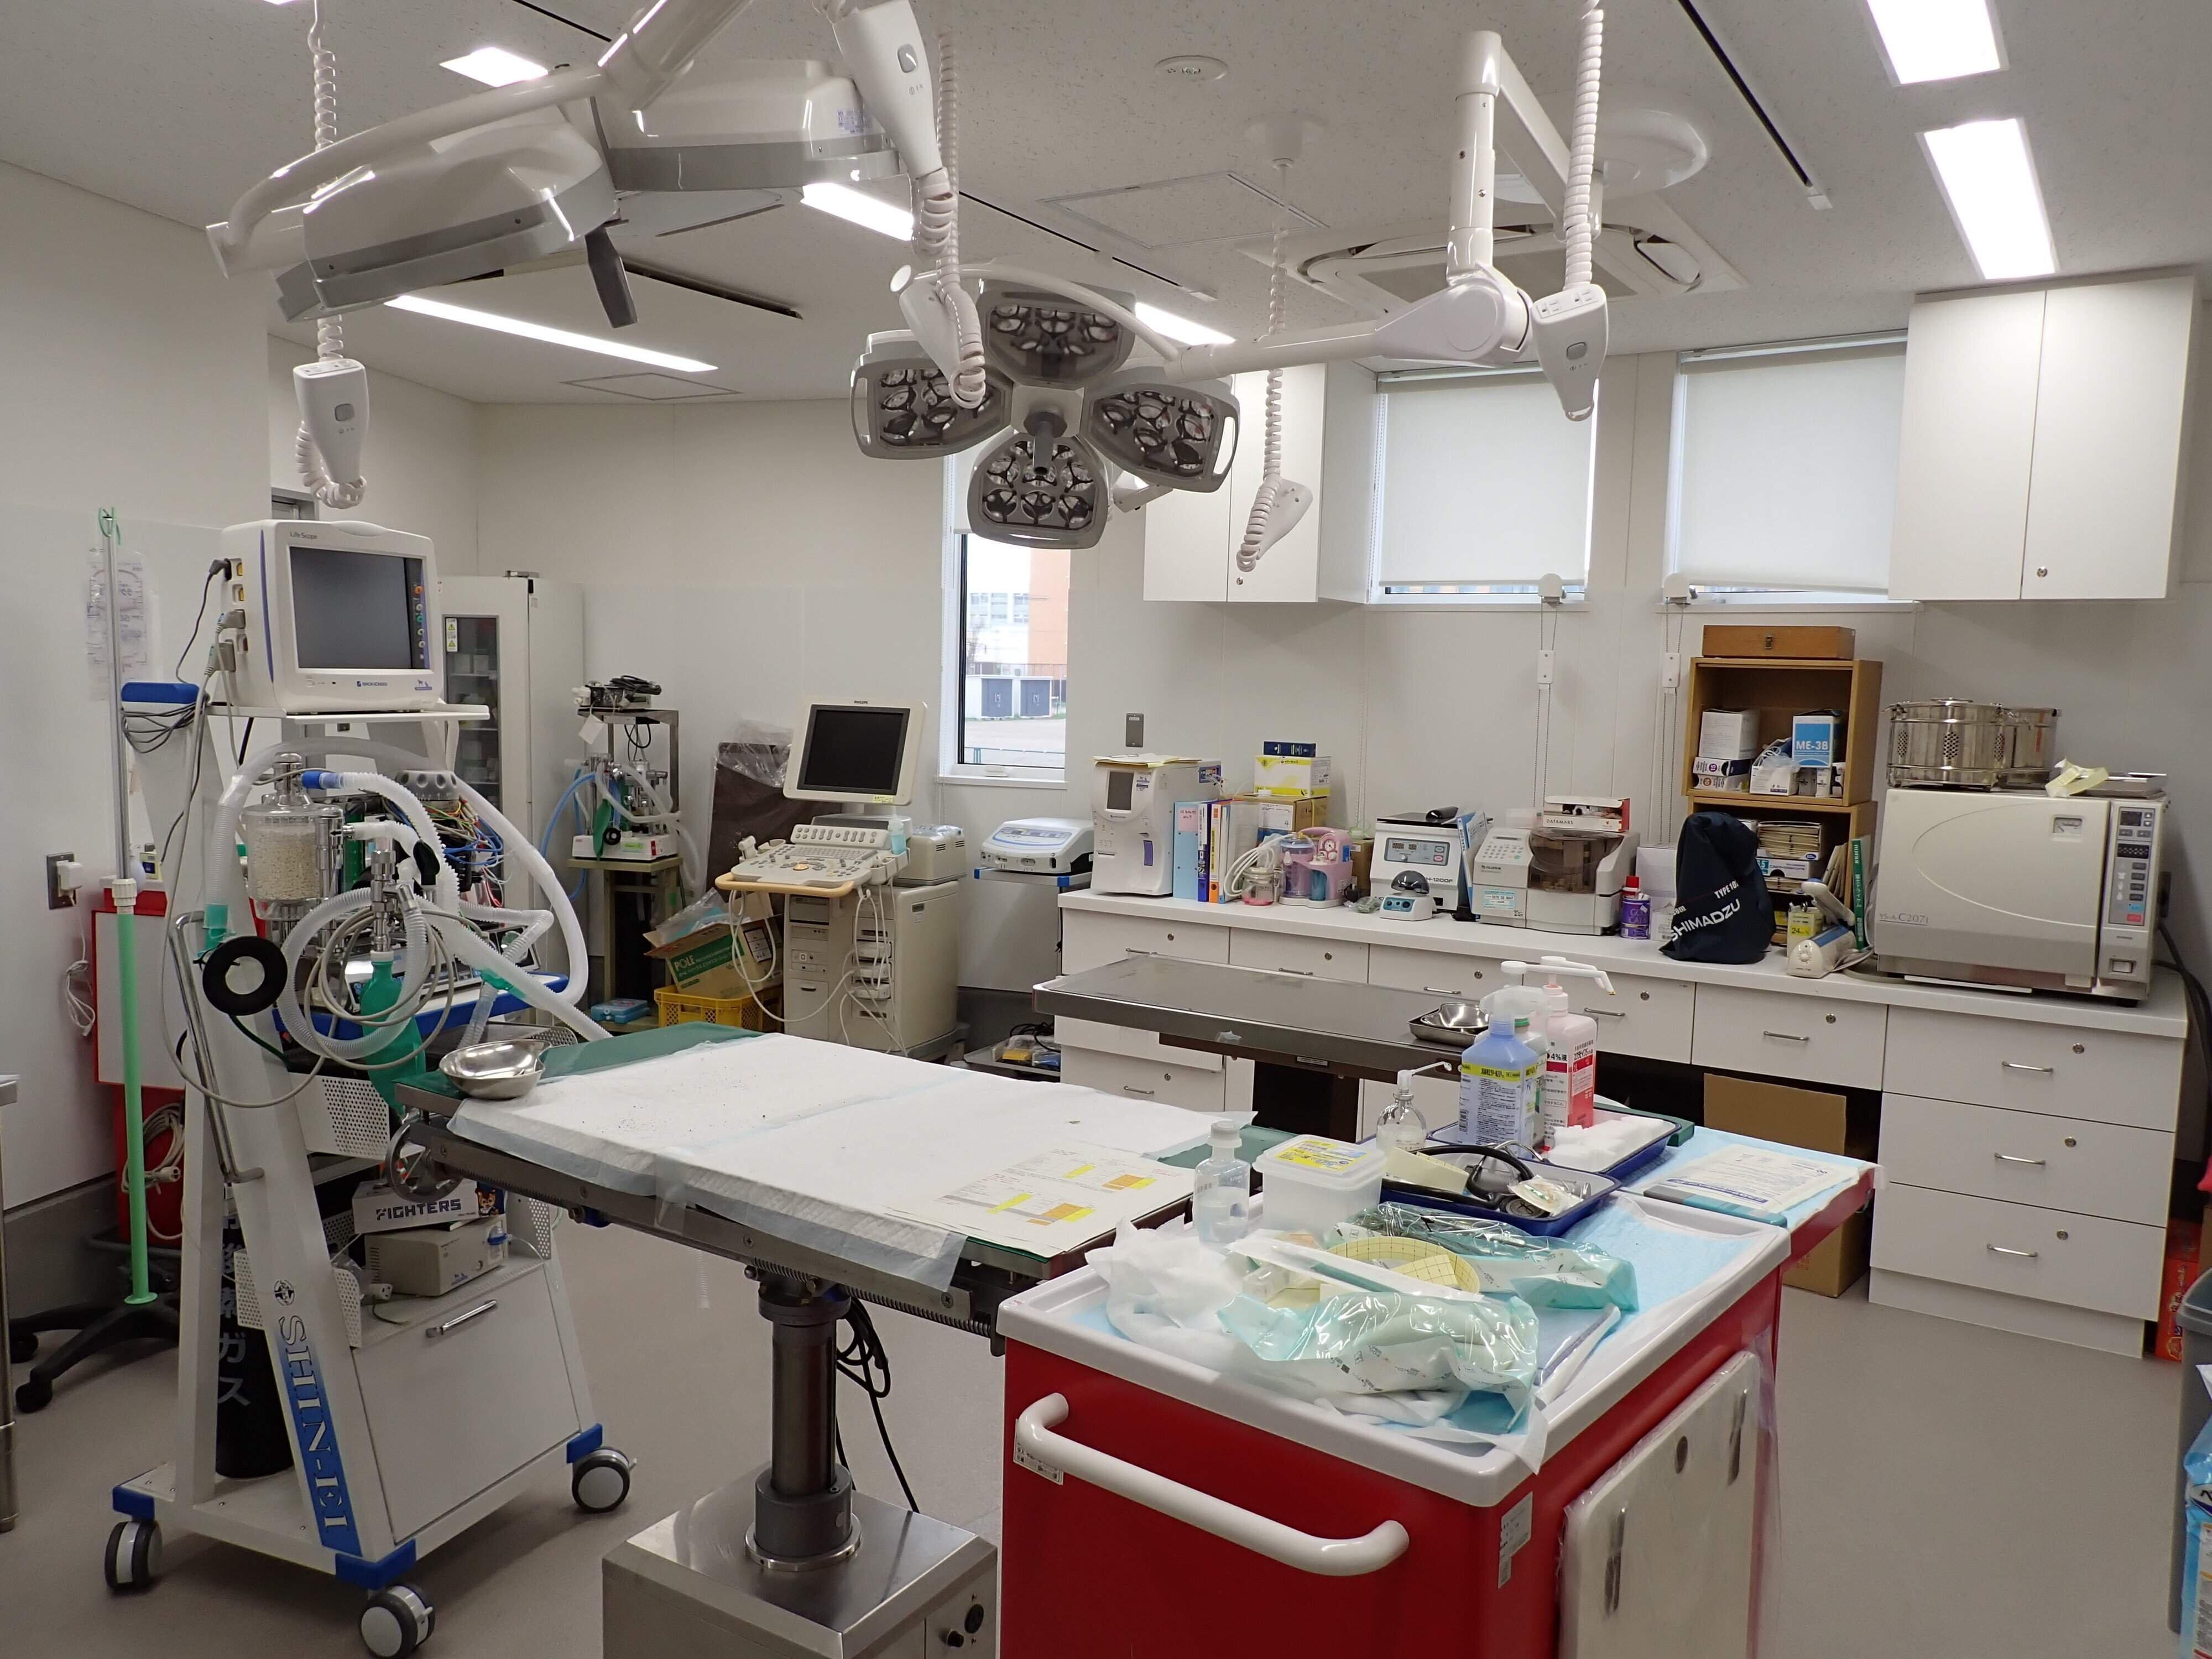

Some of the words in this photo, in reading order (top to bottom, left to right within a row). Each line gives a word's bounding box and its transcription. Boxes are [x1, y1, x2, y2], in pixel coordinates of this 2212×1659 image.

[1796, 740, 1829, 751] ME-3B
[1671, 899, 1741, 942] SHIMADZU
[674, 955, 696, 971] POLE
[376, 1198, 461, 1220] FIGHTERS
[278, 1314, 349, 1533] SHIN-EI
